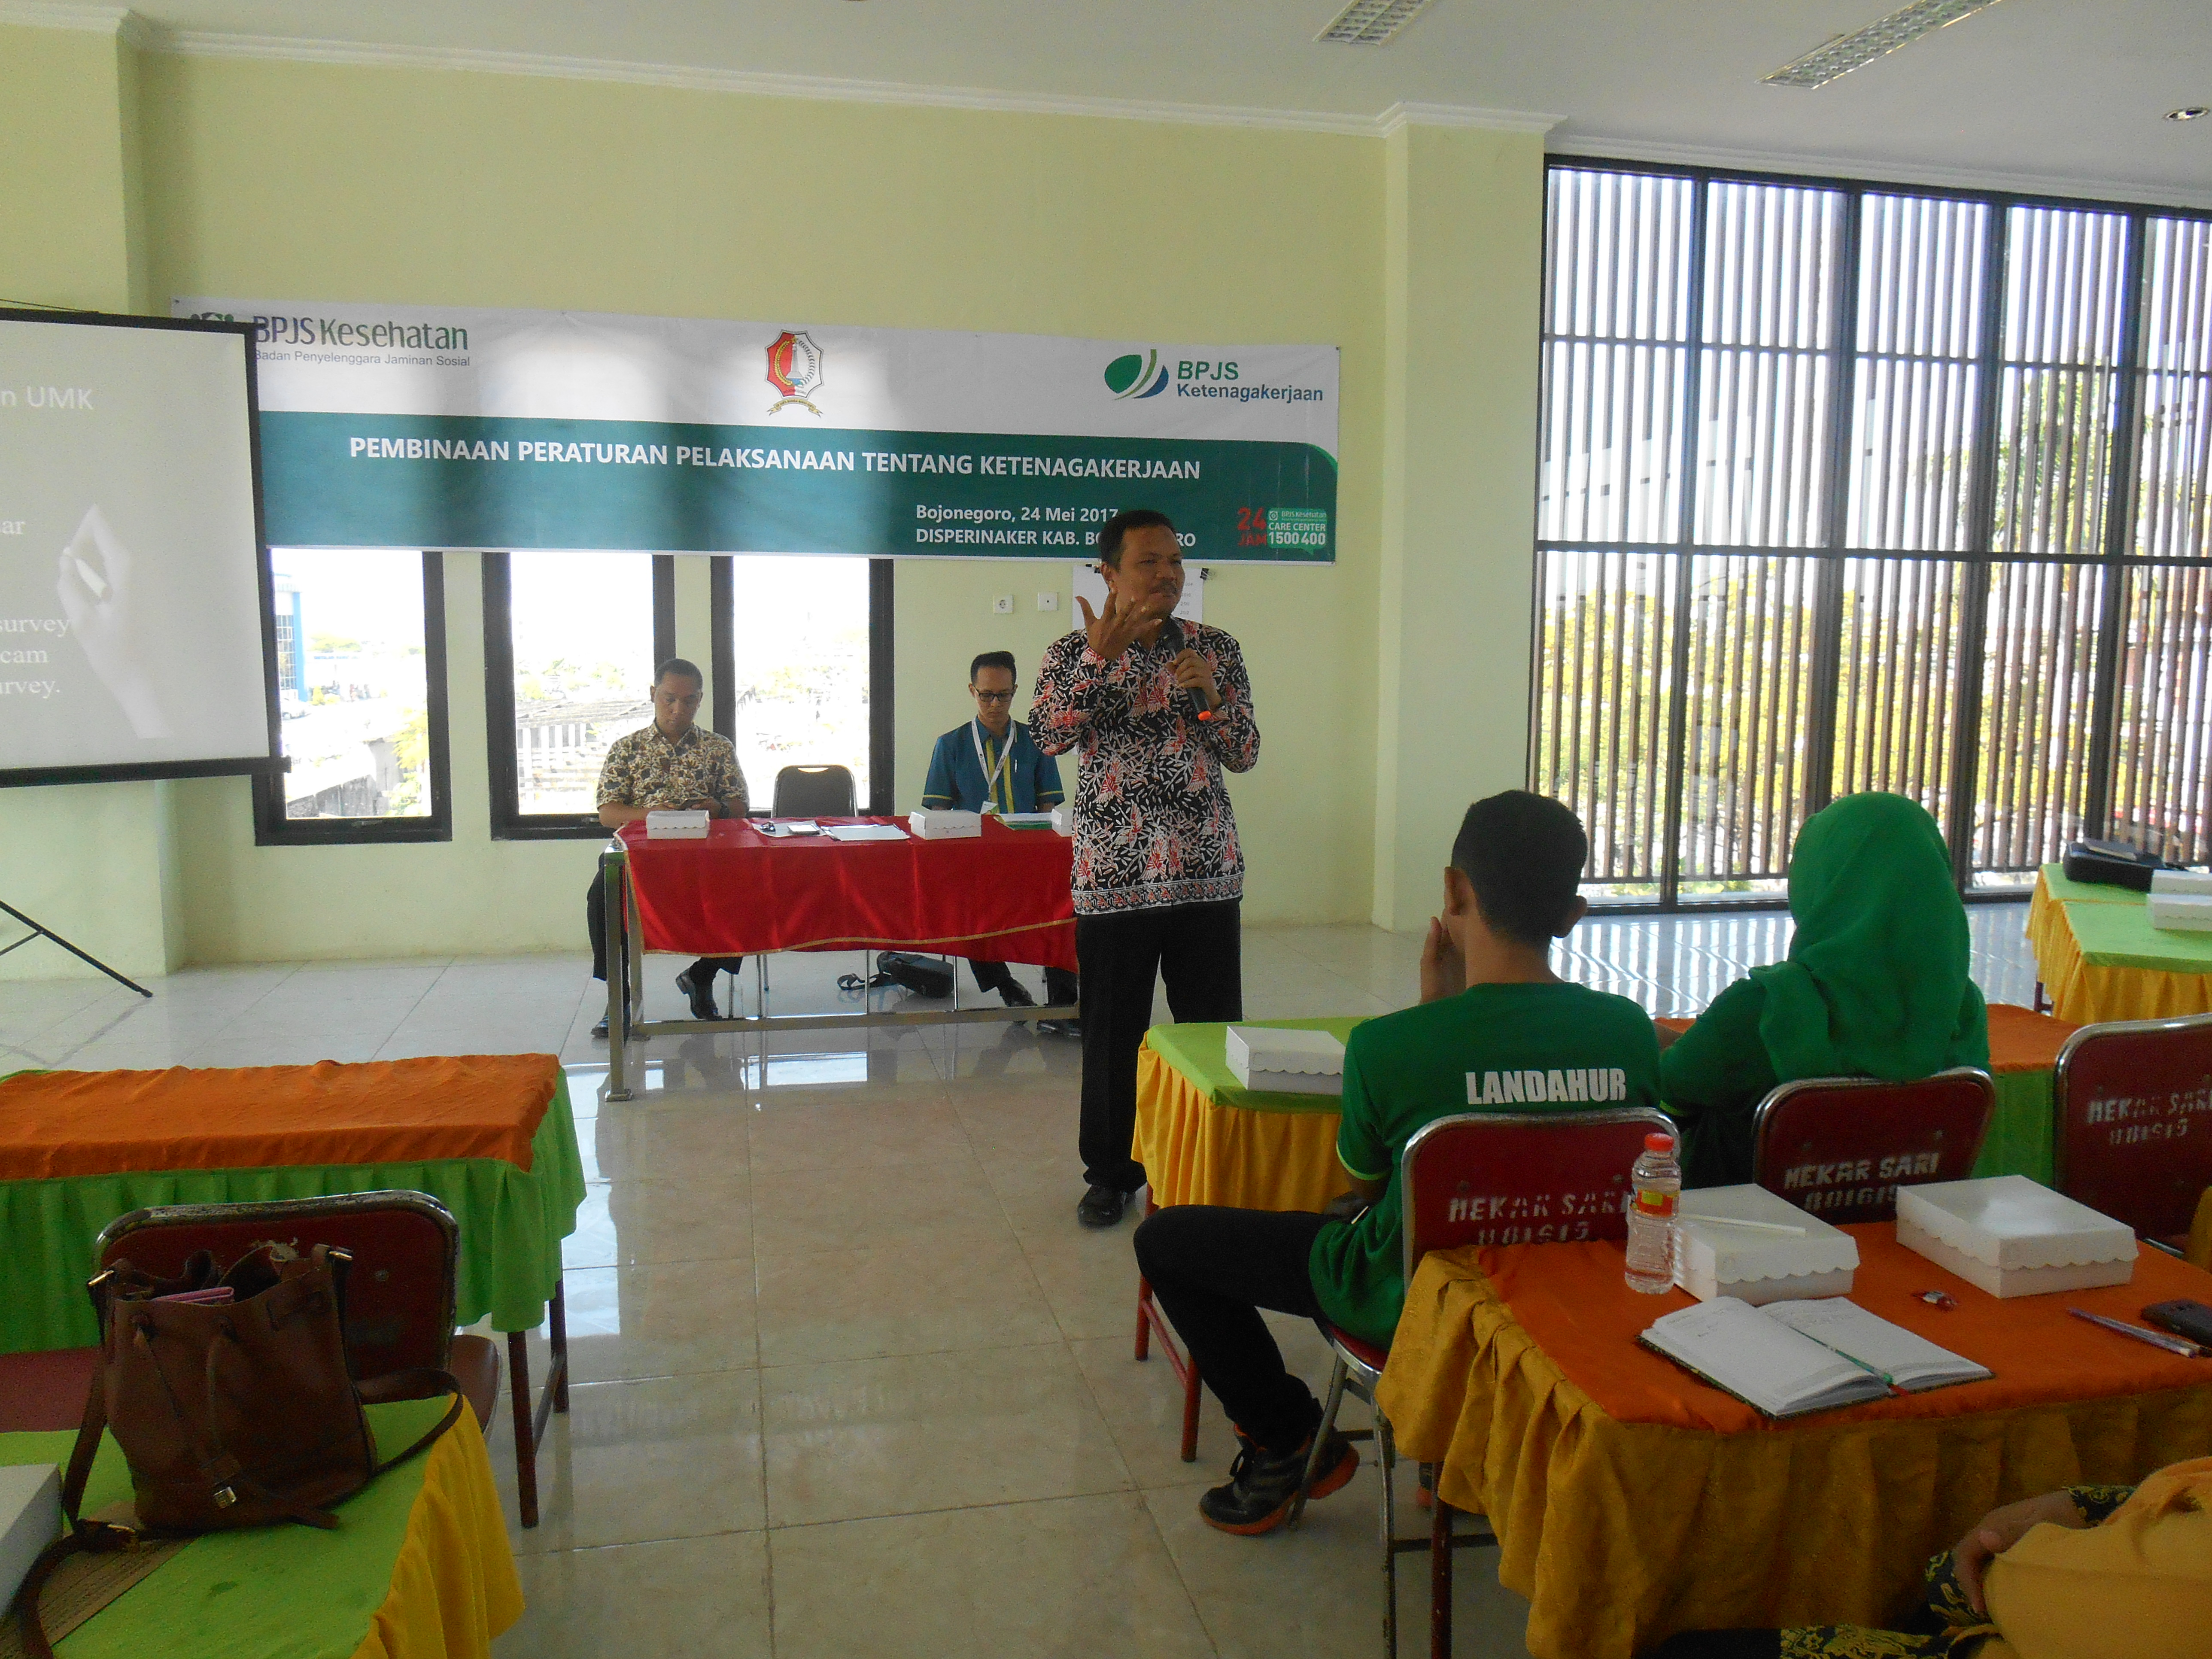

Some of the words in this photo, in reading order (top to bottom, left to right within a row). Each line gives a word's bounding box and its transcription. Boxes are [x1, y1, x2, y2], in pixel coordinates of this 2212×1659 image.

[253, 316, 315, 345] BPJS
[320, 318, 468, 350] Kesehatan
[256, 350, 291, 361] Badan
[295, 351, 381, 365] Penyelenggara
[385, 354, 432, 365] Jaminan
[437, 356, 470, 366] Sosial
[1178, 361, 1239, 380] BPJS
[27, 386, 93, 410] UMK
[1177, 383, 1323, 403] Ketenagakerjaan
[351, 437, 509, 461] PEMBINAAN
[519, 441, 667, 464] PERATURAN
[677, 446, 854, 471] PELAKSANAAN
[862, 452, 972, 474] TENTANG
[981, 456, 1200, 479] KETENAGAKERJAAN
[916, 504, 1016, 523] Bojonegoro,
[1021, 507, 1041, 520] 24
[1046, 507, 1075, 521] Mei
[1080, 508, 1118, 522] 2017
[1238, 507, 1266, 530] 24
[916, 529, 1037, 545] DISPERINAKER
[1042, 531, 1079, 545] KAB.
[1293, 523, 1325, 531] CENTER
[1465, 1068, 1627, 1105] LANDAHUR
[1784, 1159, 1871, 1190] MEKAR
[1879, 1152, 1939, 1179] SARI
